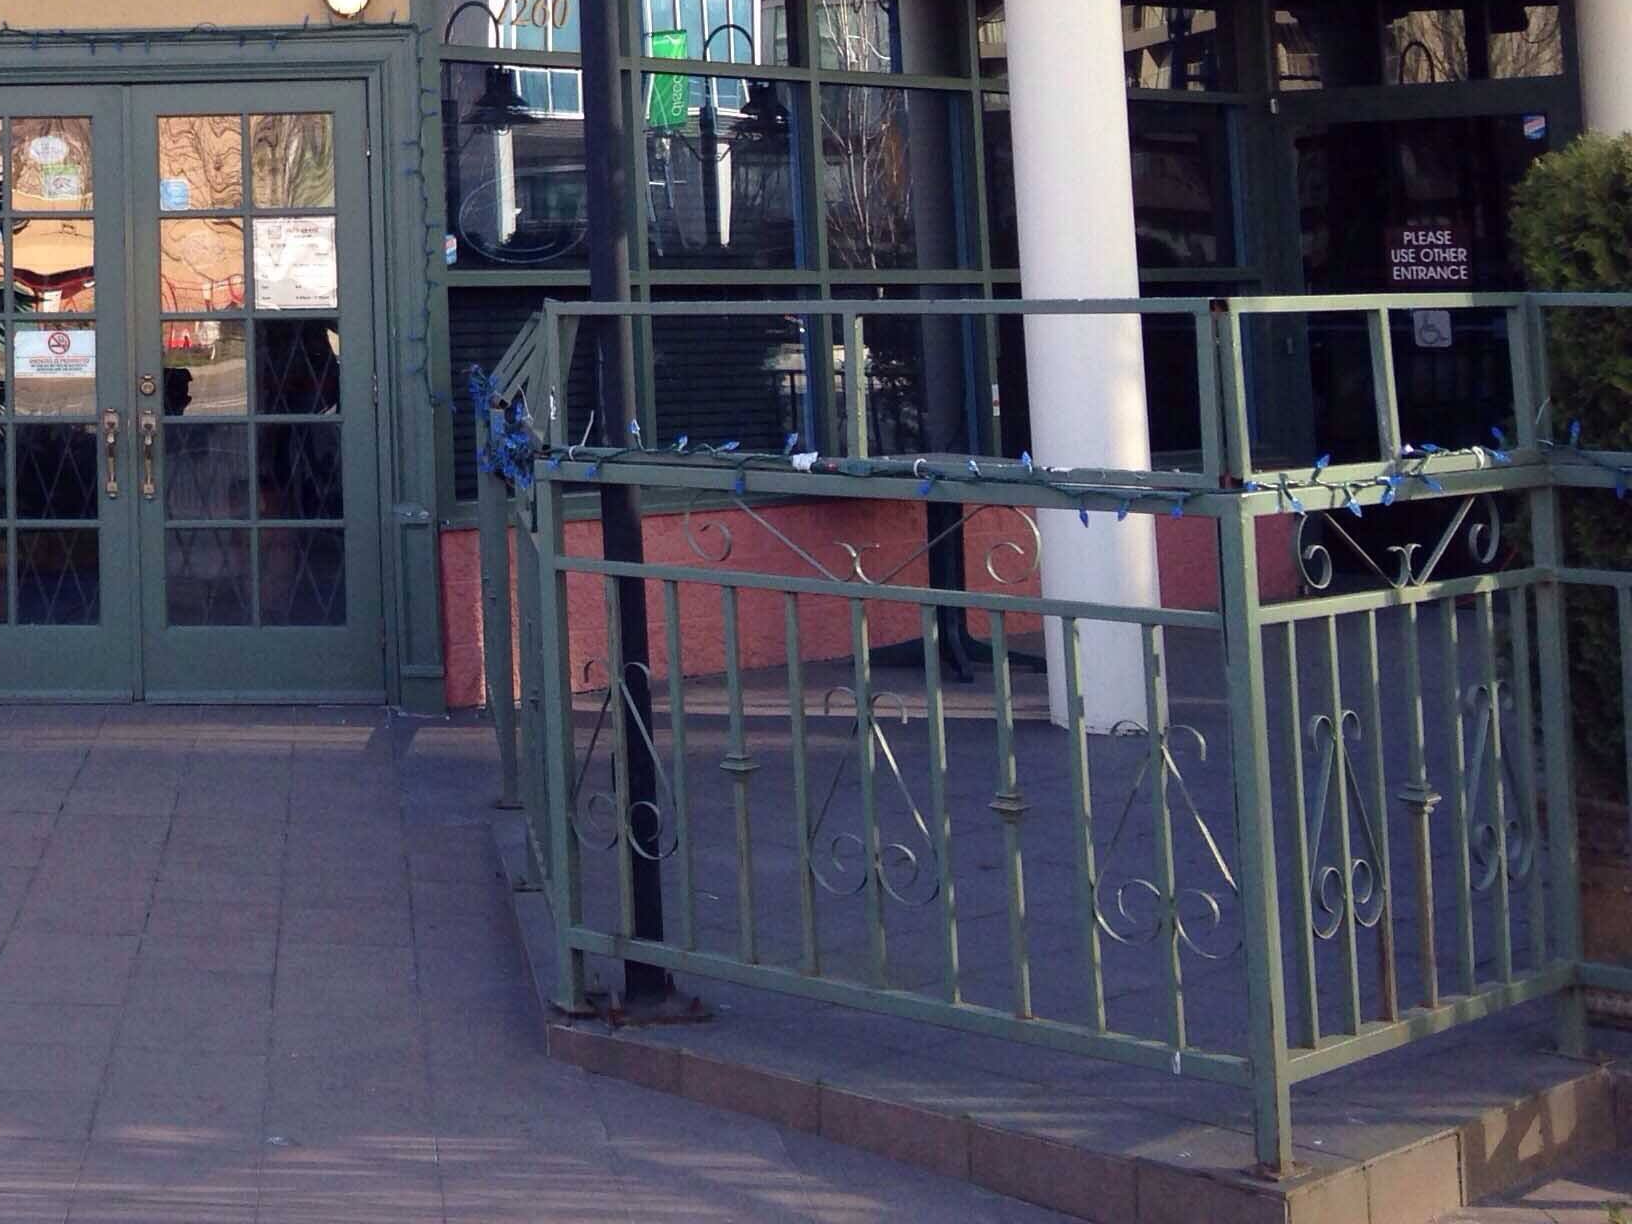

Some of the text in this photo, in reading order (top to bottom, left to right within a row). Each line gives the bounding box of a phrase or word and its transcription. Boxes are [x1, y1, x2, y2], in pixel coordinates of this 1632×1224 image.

[1403, 230, 1452, 245] PLEASE
[1391, 248, 1467, 263] USE OTHER
[1393, 265, 1468, 280] ENTRANCE
